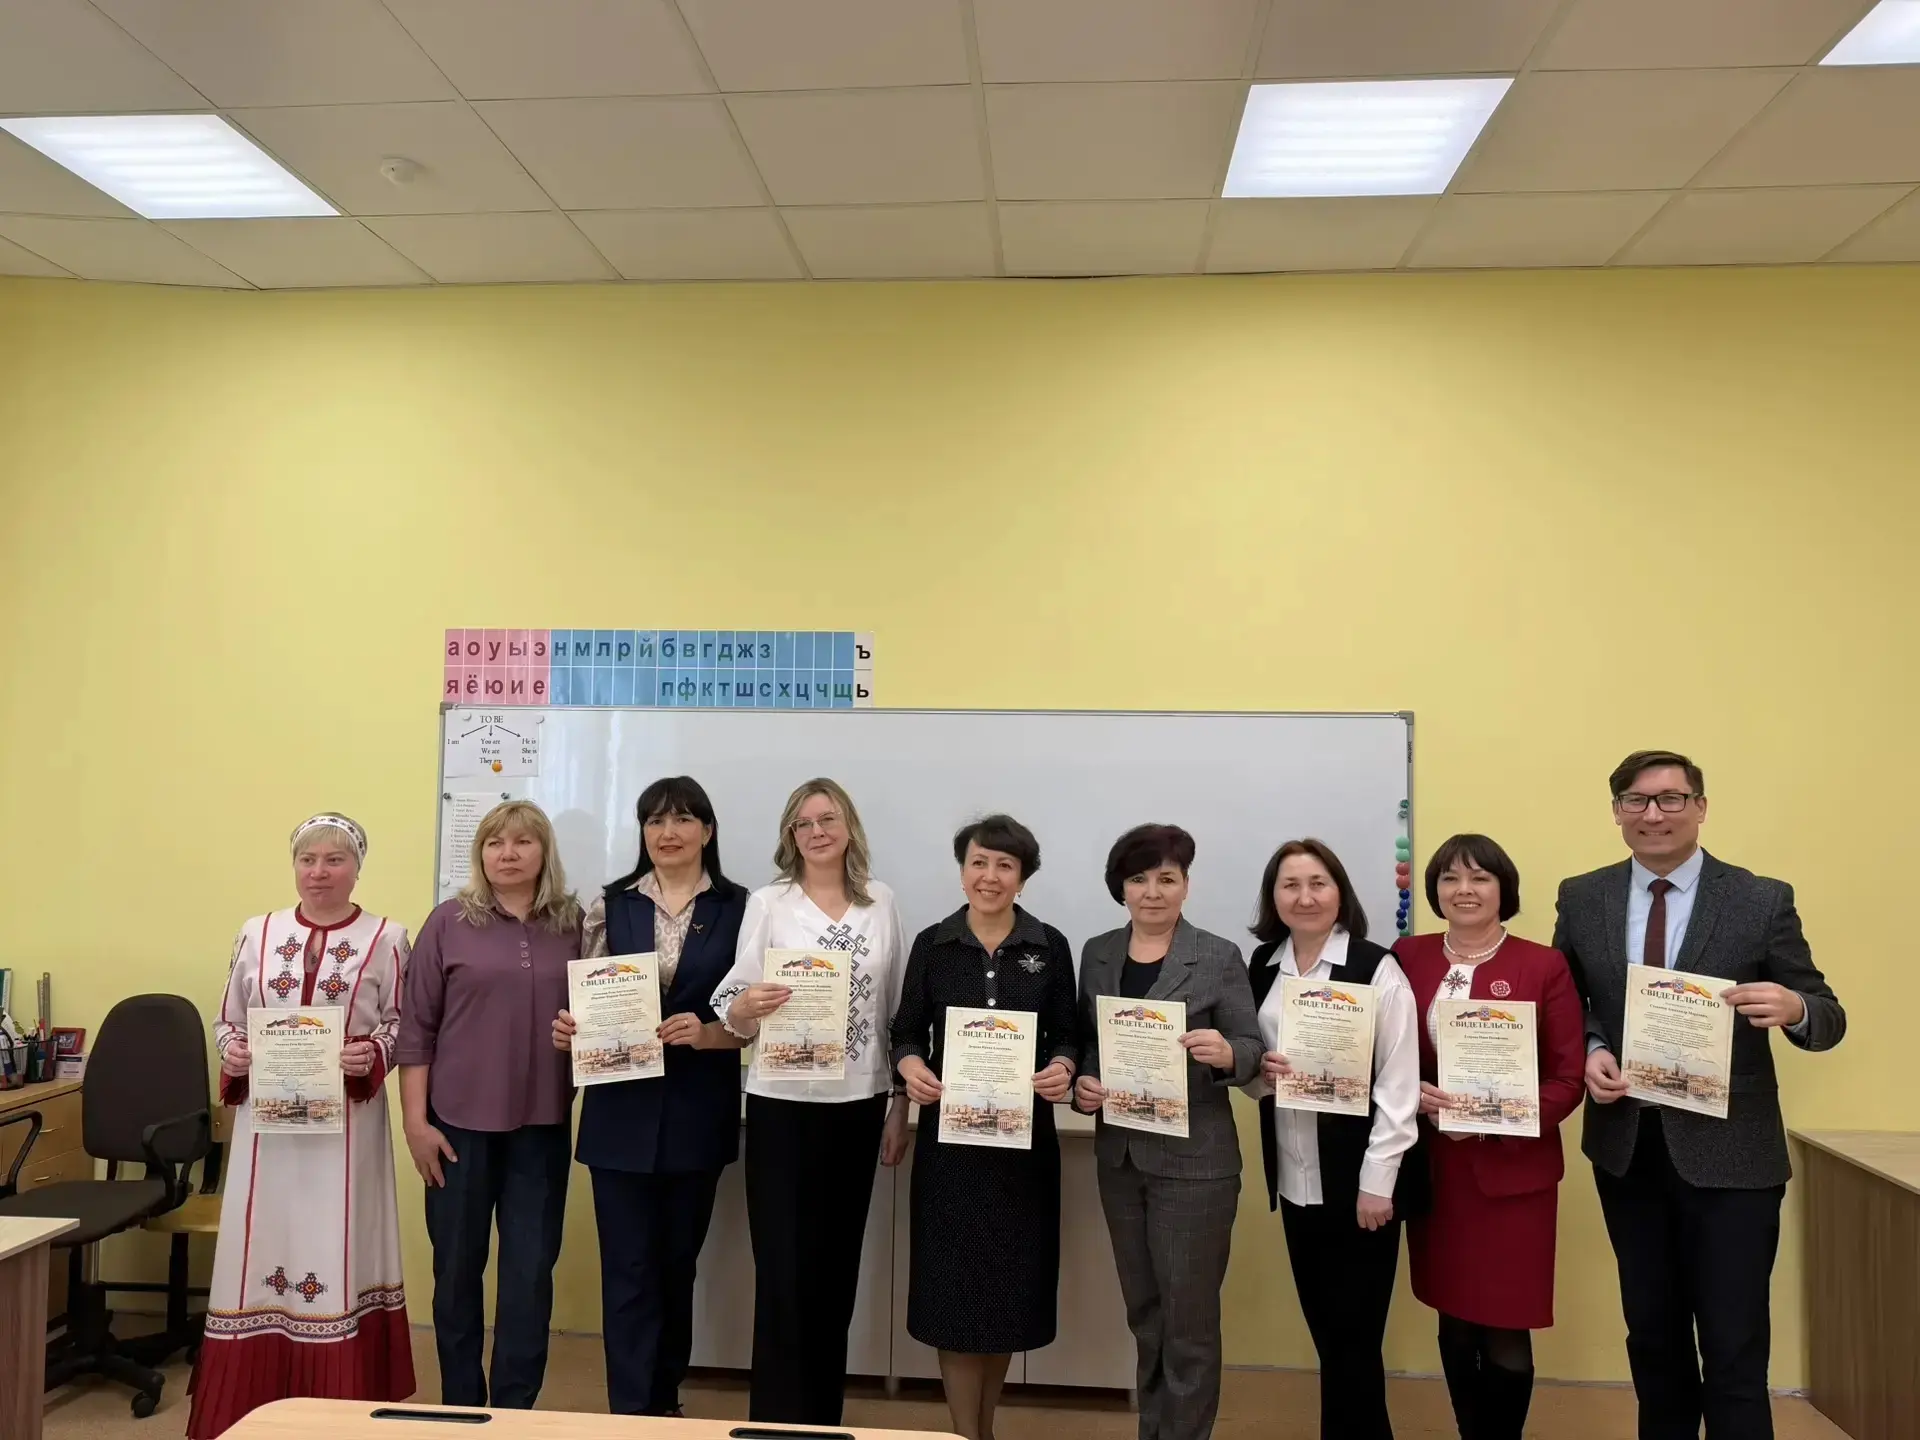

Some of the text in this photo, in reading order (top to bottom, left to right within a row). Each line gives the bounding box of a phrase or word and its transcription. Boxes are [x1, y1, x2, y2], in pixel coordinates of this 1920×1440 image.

[448, 641, 459, 656] а
[467, 641, 480, 656] о
[489, 641, 501, 661] у
[509, 641, 526, 656] ы
[534, 641, 546, 656] э
[555, 641, 566, 656] н
[575, 642, 590, 656] м
[596, 642, 610, 657] л
[618, 641, 630, 661] р
[640, 637, 652, 658] й
[662, 637, 675, 657] б
[683, 643, 695, 657] в
[703, 643, 713, 658] г
[718, 643, 733, 661] д
[737, 643, 754, 658] ж
[760, 643, 770, 658] з
[446, 679, 458, 694] я
[466, 674, 478, 694] ё
[485, 679, 503, 694] ю
[511, 679, 523, 694] и
[533, 679, 545, 694] е
[662, 681, 674, 696] п
[678, 677, 696, 701] ф
[702, 682, 713, 696] к
[718, 682, 730, 696] т
[736, 682, 753, 697] ш
[760, 682, 771, 697] с
[778, 683, 790, 697] х
[797, 683, 809, 700] ц
[816, 683, 828, 697] ч
[834, 683, 852, 700] щ
[480, 715, 504, 724] TO BE
[479, 757, 492, 765] They
[776, 969, 840, 978] СВИДЕТЕЛЬСТВО
[580, 974, 648, 987] СВИДЕТЕЛЬСТВО
[1641, 988, 1720, 1009] СВИДЕТЕЛЬСТВО
[1292, 999, 1364, 1013] СВИДЕТЕЛЬСТВО
[1108, 1018, 1174, 1031] СВИДЕТЕЛЬСТВО
[1449, 1020, 1524, 1030] СВИДЕТЕЛЬСТВО
[260, 1028, 332, 1036] СВИДЕТЕЛЬСТВО
[957, 1029, 1025, 1041] СВИДЕТЕЛЬСТВО
